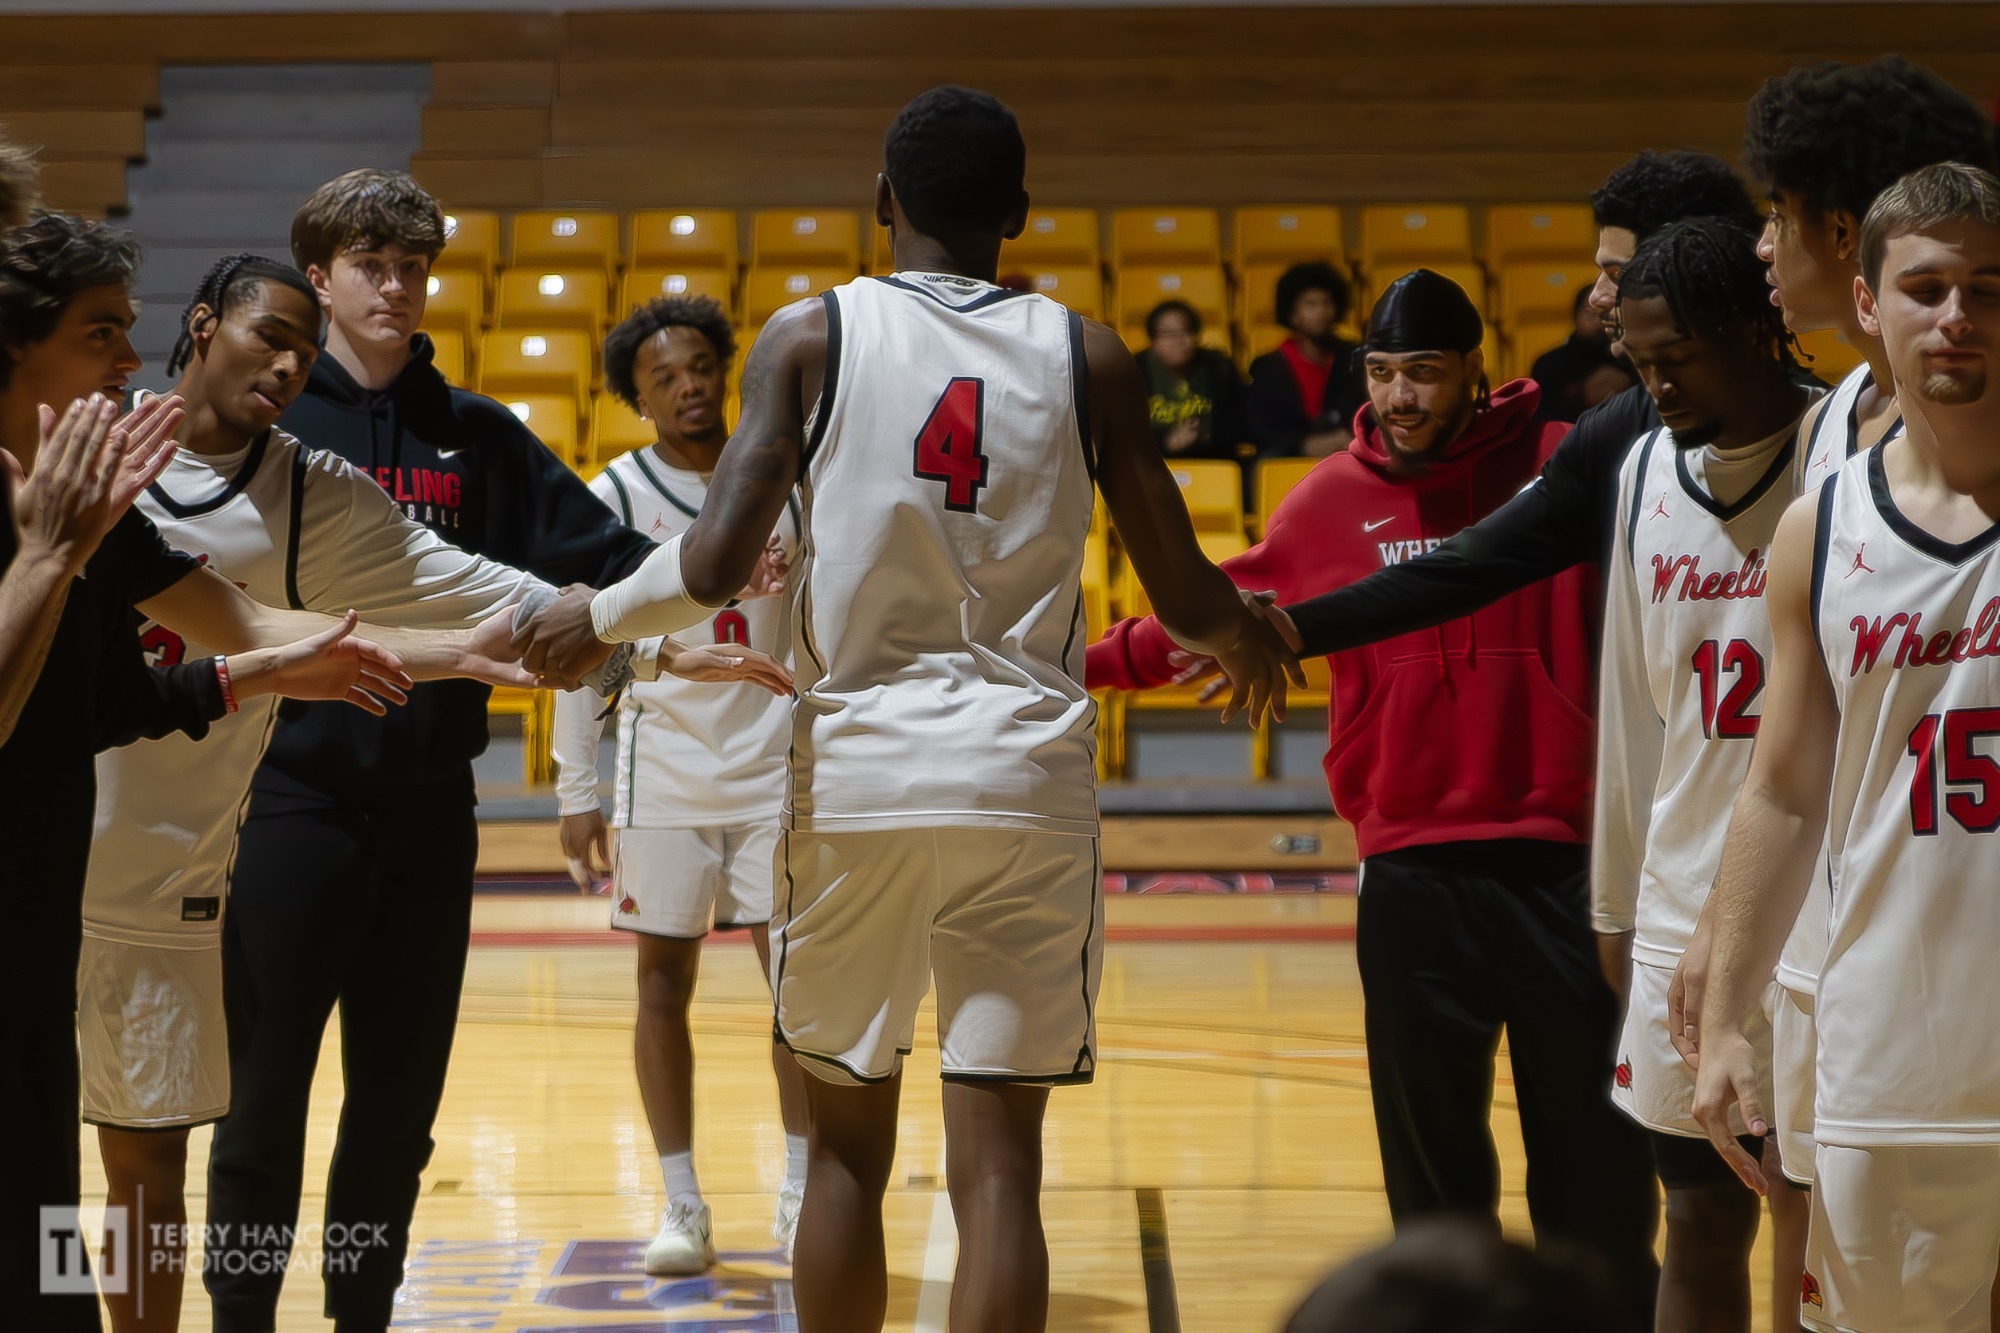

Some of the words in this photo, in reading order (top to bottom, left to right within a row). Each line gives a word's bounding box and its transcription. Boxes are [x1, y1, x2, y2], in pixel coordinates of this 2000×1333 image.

[358, 466, 461, 509] ELING
[913, 376, 990, 515] 4
[1691, 638, 1766, 740] 12
[1907, 706, 2000, 837] 15
